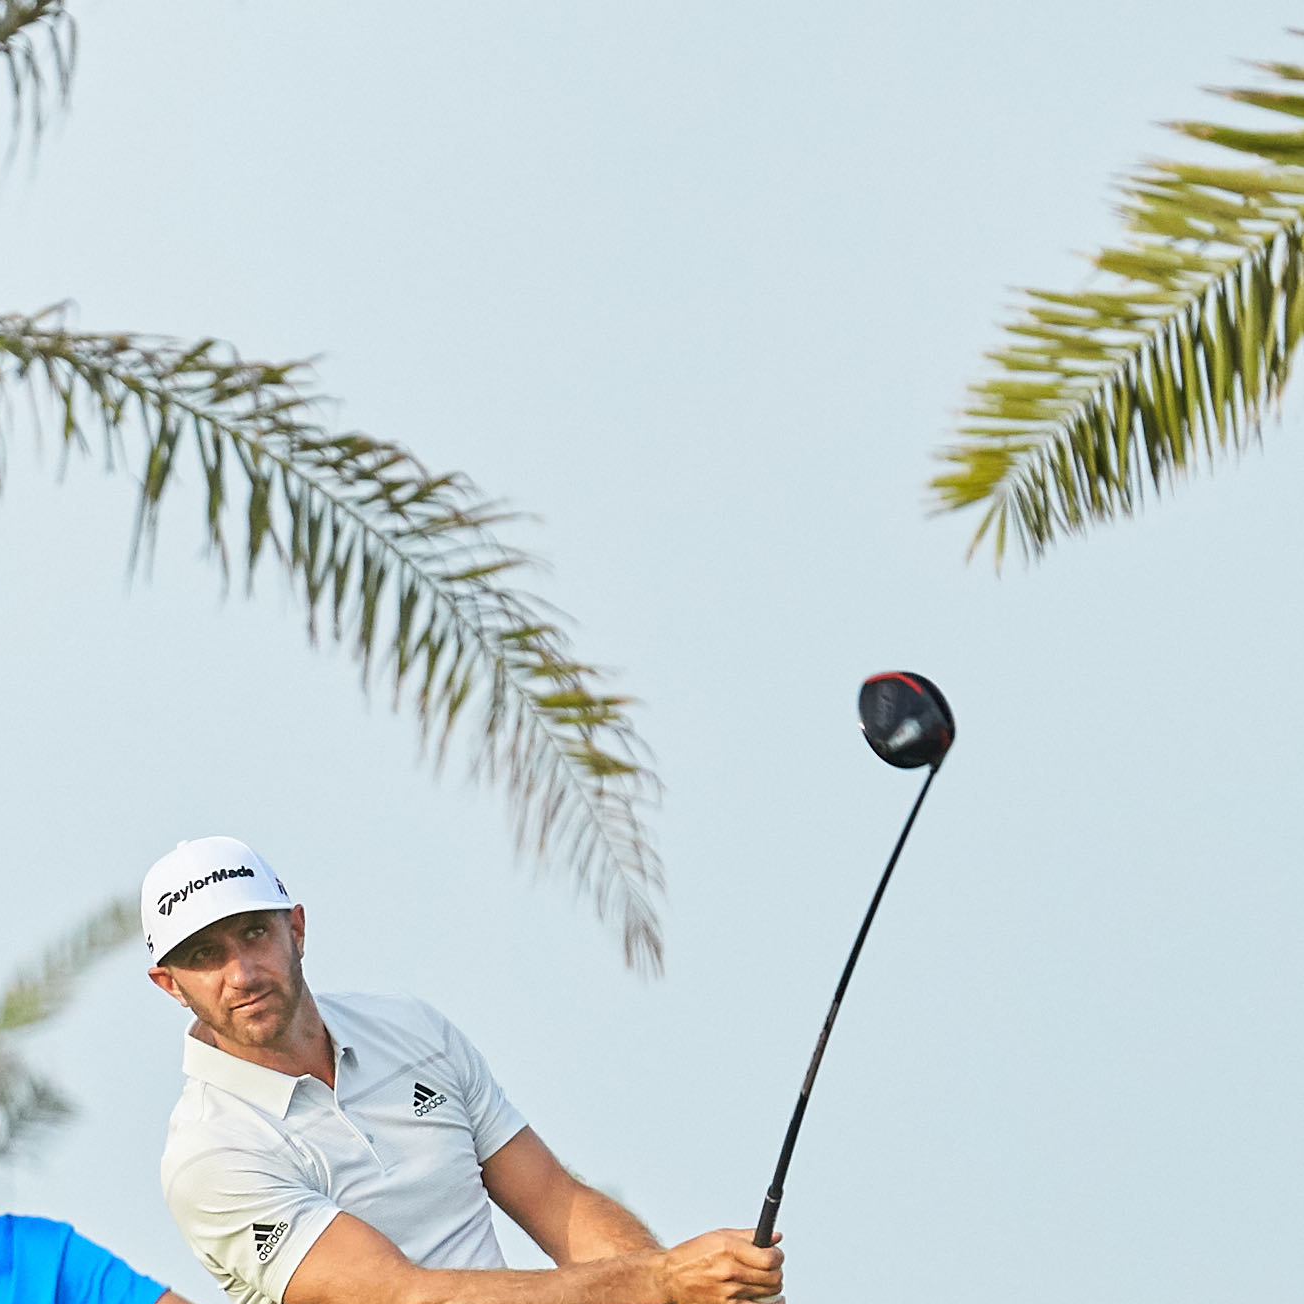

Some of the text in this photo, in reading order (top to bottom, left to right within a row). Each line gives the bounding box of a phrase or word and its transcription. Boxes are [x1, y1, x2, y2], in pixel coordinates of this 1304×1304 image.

[157, 865, 255, 916] TaylorMade
[414, 1094, 447, 1117] adidas
[259, 1221, 289, 1261] adidas
